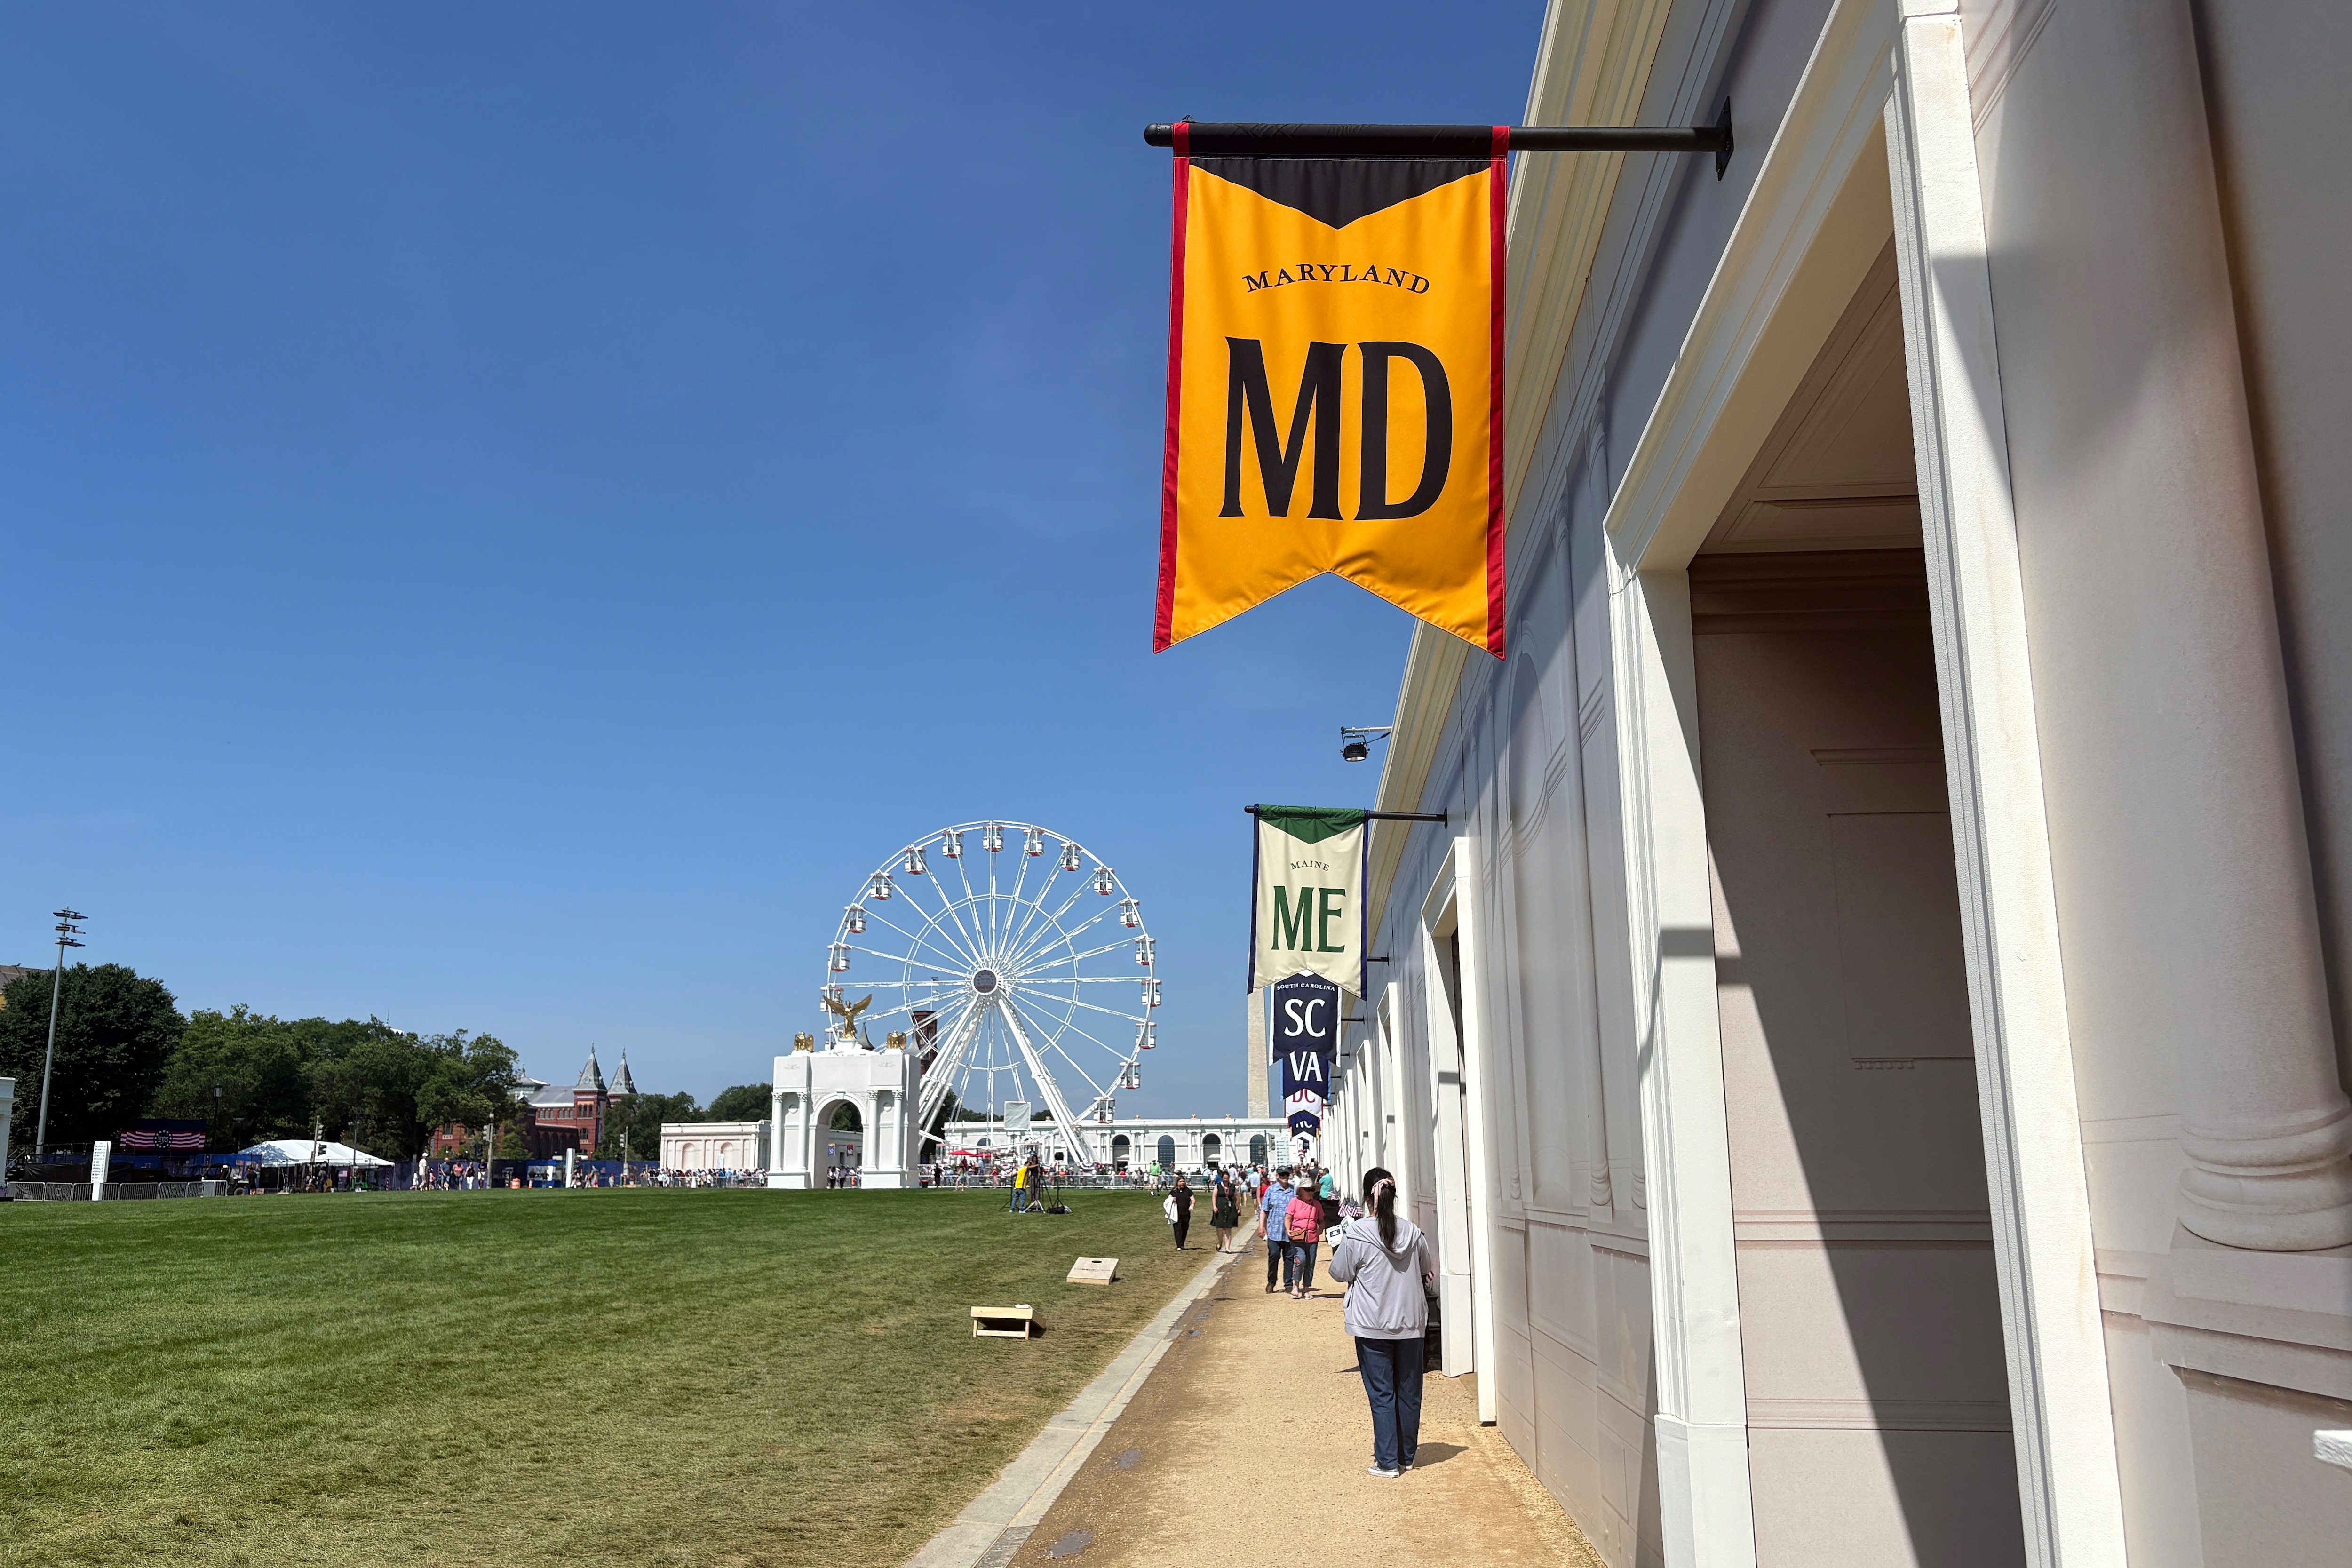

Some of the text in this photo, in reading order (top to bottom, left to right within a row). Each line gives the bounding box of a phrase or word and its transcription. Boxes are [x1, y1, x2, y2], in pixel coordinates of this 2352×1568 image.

[1242, 263, 1430, 294] MARYLAND
[1218, 337, 1452, 520] MD
[1290, 860, 1329, 871] MAINE
[1271, 885, 1346, 953] ME
[1284, 999, 1326, 1037] SC
[1289, 1051, 1323, 1081] VA
